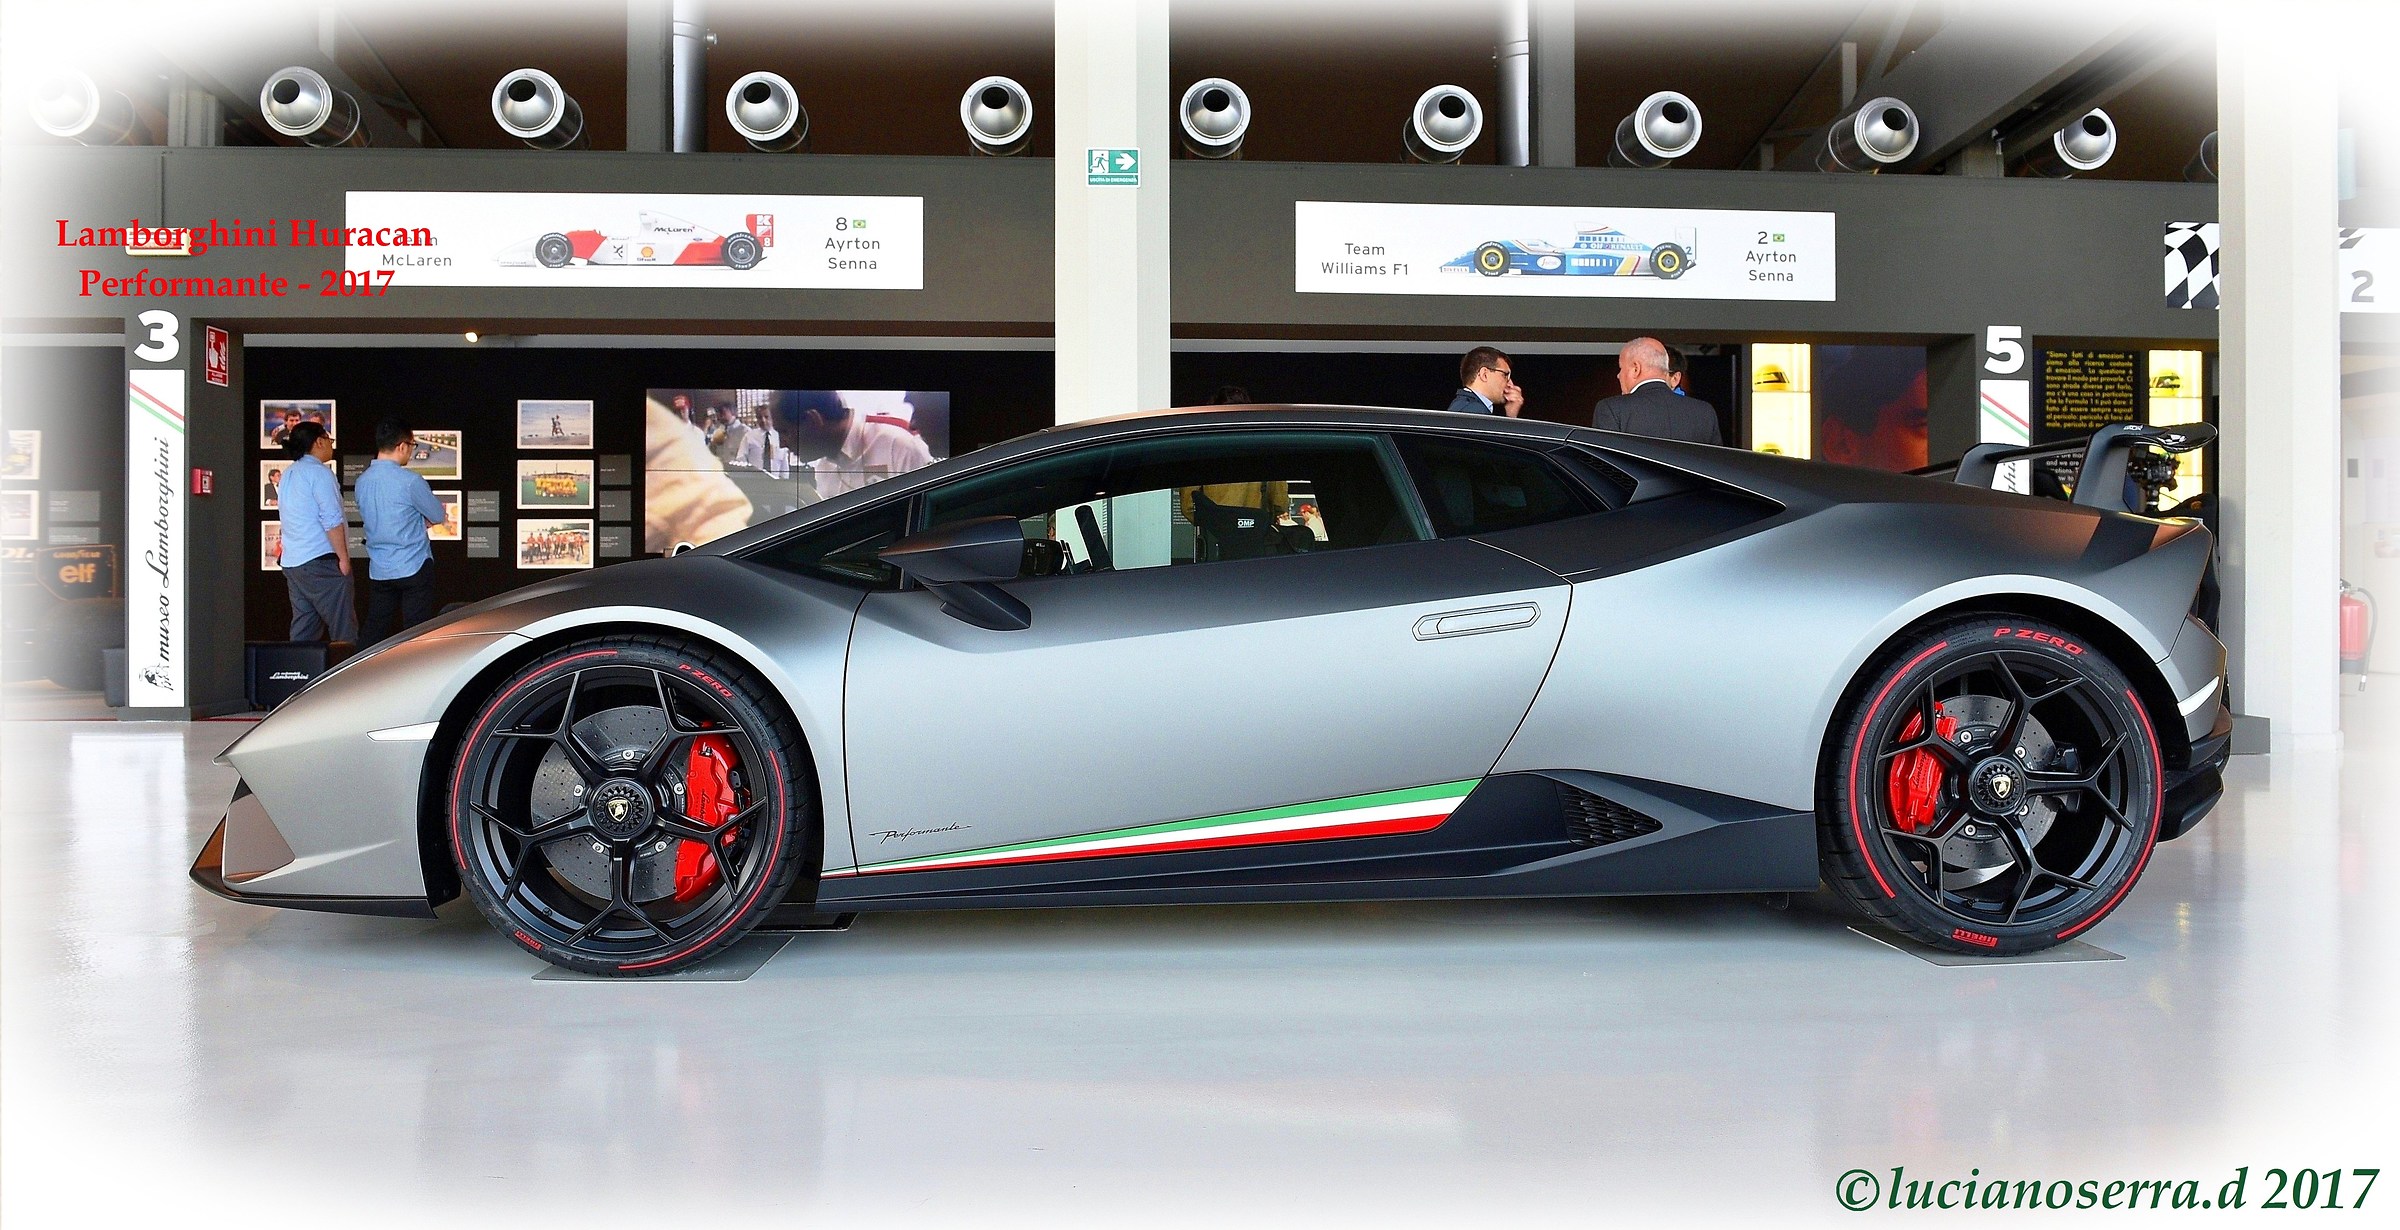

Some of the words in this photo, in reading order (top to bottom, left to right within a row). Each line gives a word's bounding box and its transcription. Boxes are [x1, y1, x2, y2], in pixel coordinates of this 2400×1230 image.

[836, 217, 847, 231] 8
[763, 237, 771, 247] 8
[825, 237, 880, 252] Ayrton
[1758, 231, 1768, 244] 2
[1344, 242, 1385, 256] Team
[1685, 246, 1692, 256] 2
[382, 254, 452, 266] McLaren
[828, 257, 877, 269] Senna
[1746, 250, 1796, 265] Ayrton
[1321, 262, 1387, 275] Williams
[1393, 263, 1408, 276] F1
[1748, 269, 1794, 282] Senna
[2351, 270, 2375, 302] 2
[133, 309, 180, 363] 3
[1984, 325, 2025, 375] 5
[145, 437, 174, 589] Lamborghini
[59, 563, 96, 583] elf
[159, 592, 170, 662] museo
[1993, 627, 2012, 638] P
[2014, 628, 2083, 655] ZERO
[678, 662, 692, 671] P
[691, 669, 733, 698] ZERO
[868, 822, 973, 844] Performante
[1952, 928, 1998, 947] PIRELLI
